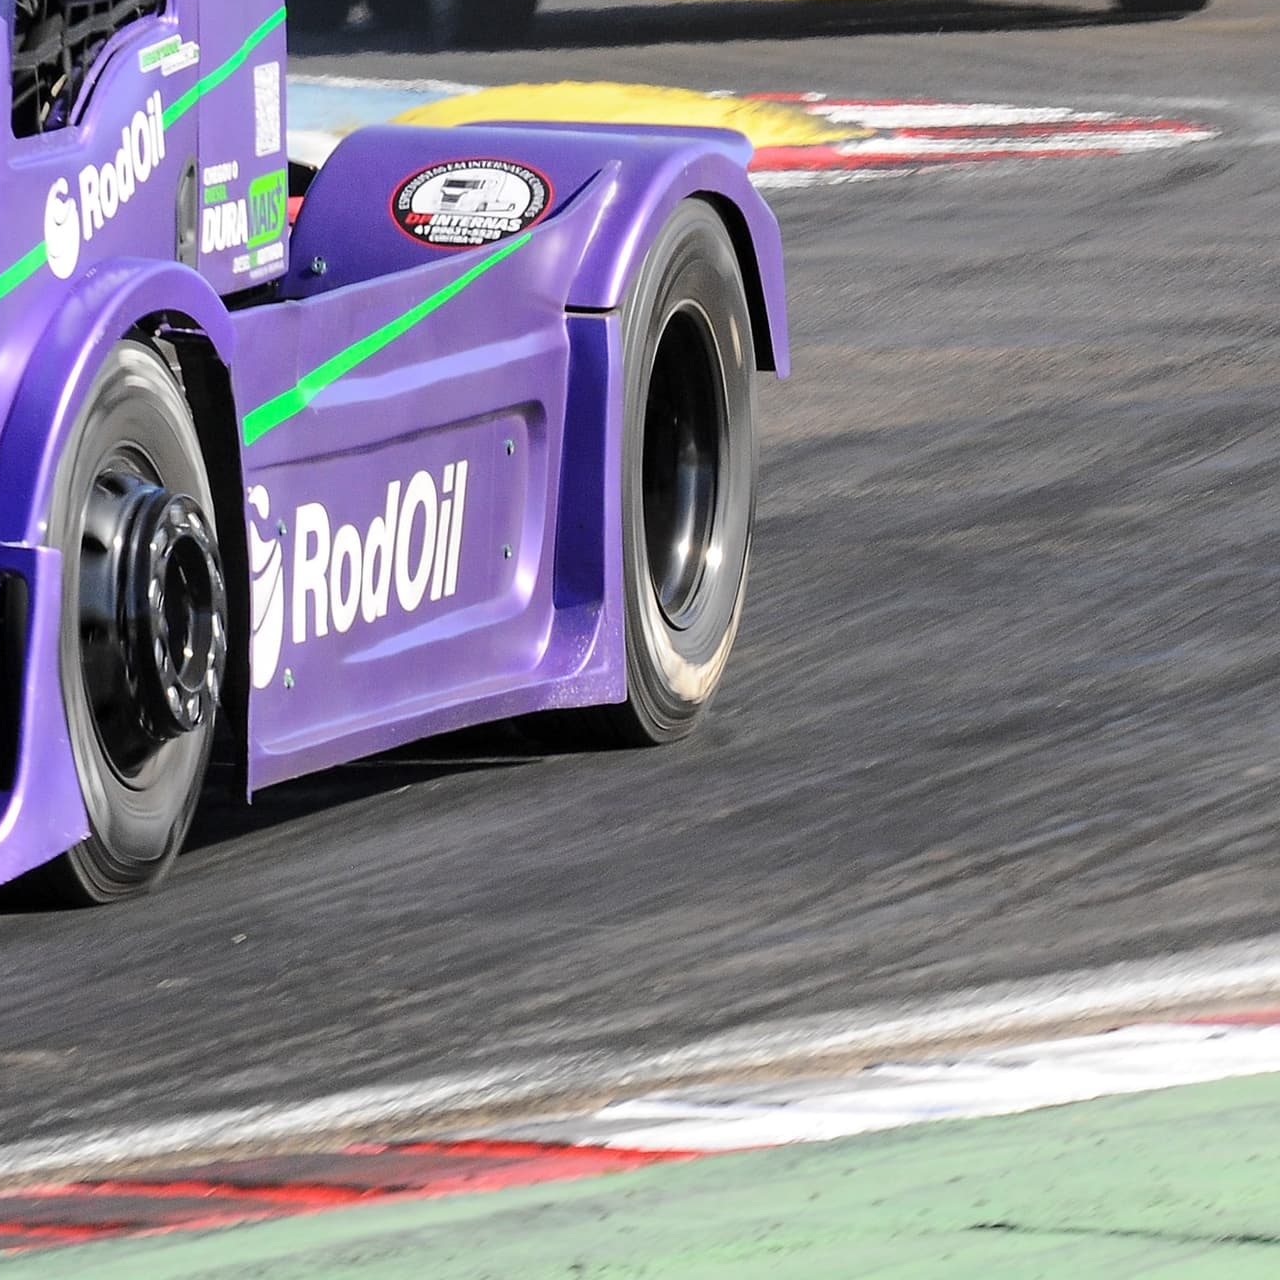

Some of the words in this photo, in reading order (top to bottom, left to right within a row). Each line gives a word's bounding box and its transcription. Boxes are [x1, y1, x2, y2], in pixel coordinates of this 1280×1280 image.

[79, 90, 166, 241] RodOil
[201, 198, 249, 254] DURA
[292, 459, 469, 645] RodOil
